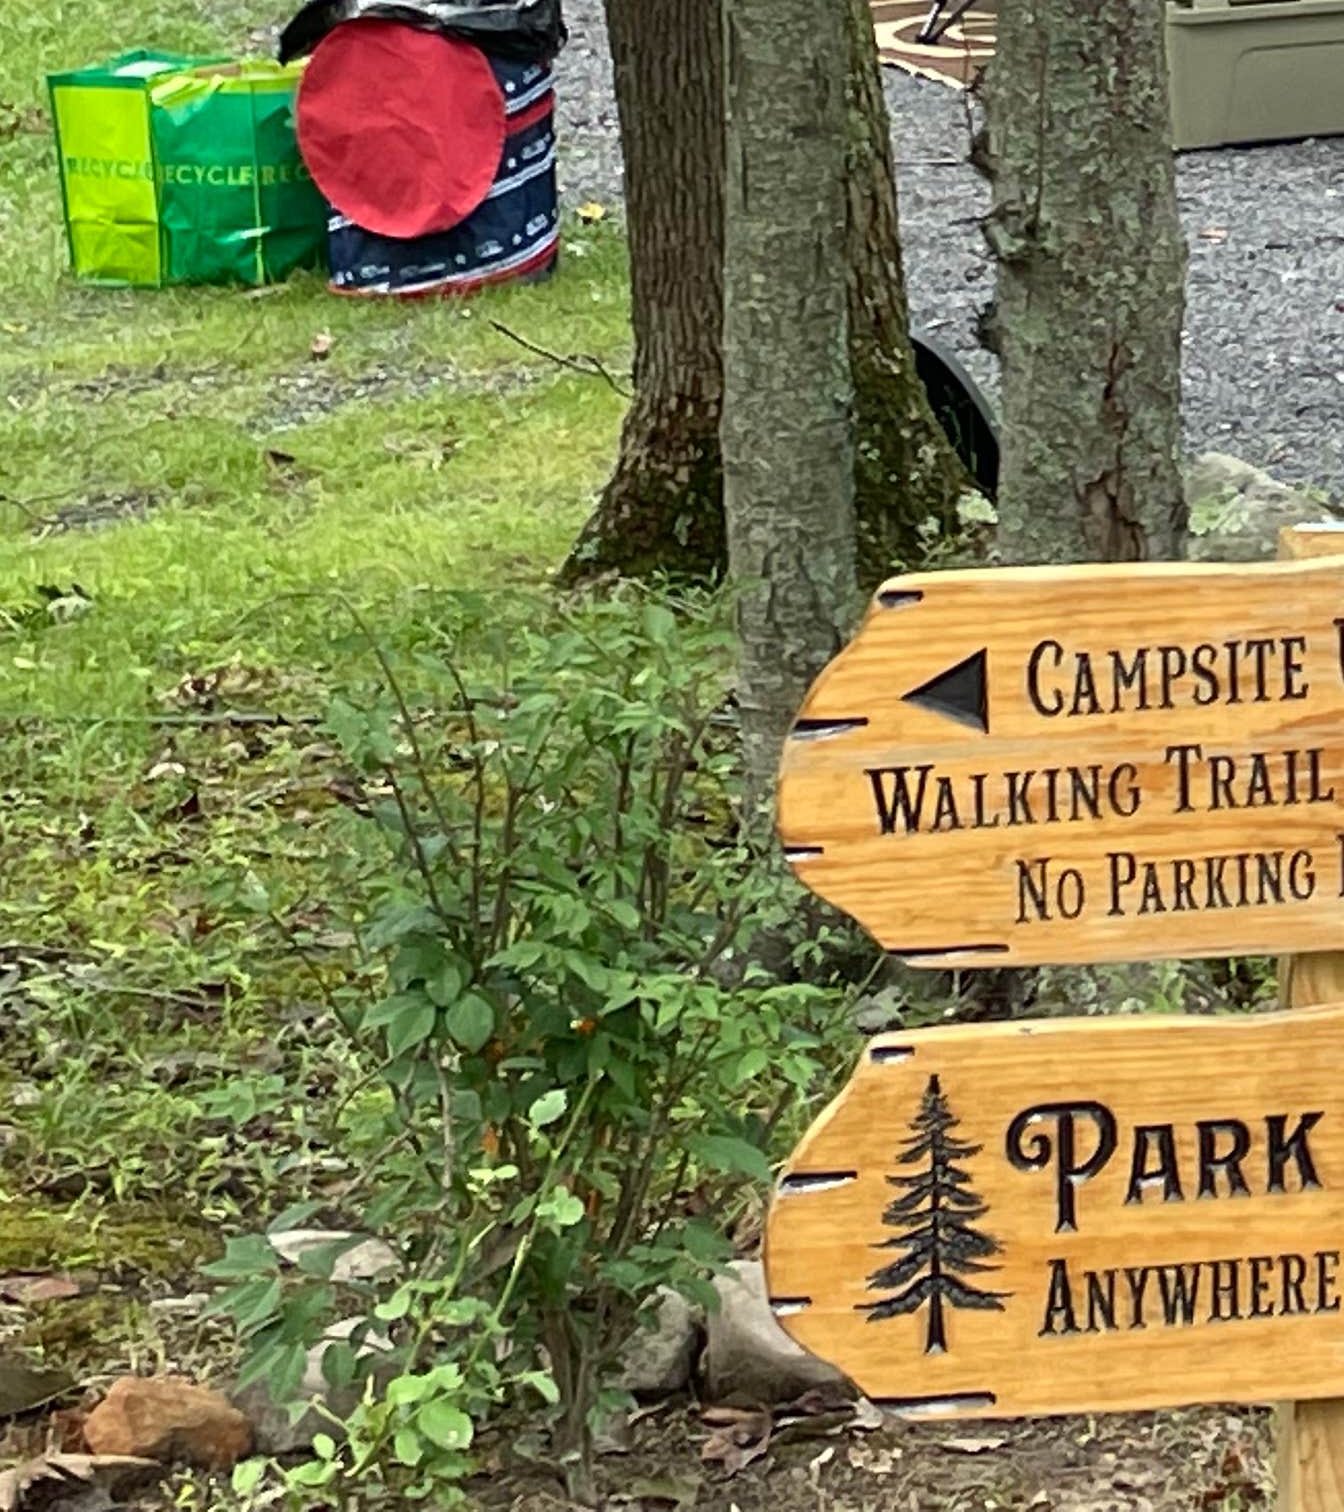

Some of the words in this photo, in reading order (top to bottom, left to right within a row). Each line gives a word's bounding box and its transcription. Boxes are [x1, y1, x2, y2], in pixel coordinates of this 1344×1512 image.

[162, 164, 253, 186] ECYCLE
[1027, 636, 1308, 716] CAMPSITE
[864, 763, 1140, 835] WALKING
[1165, 745, 1334, 813] TRAIL
[1016, 857, 1085, 923] NO
[1106, 850, 1315, 915] PARKING
[1006, 1101, 1324, 1232] PARK
[1038, 1251, 1341, 1337] ANYWHERE
